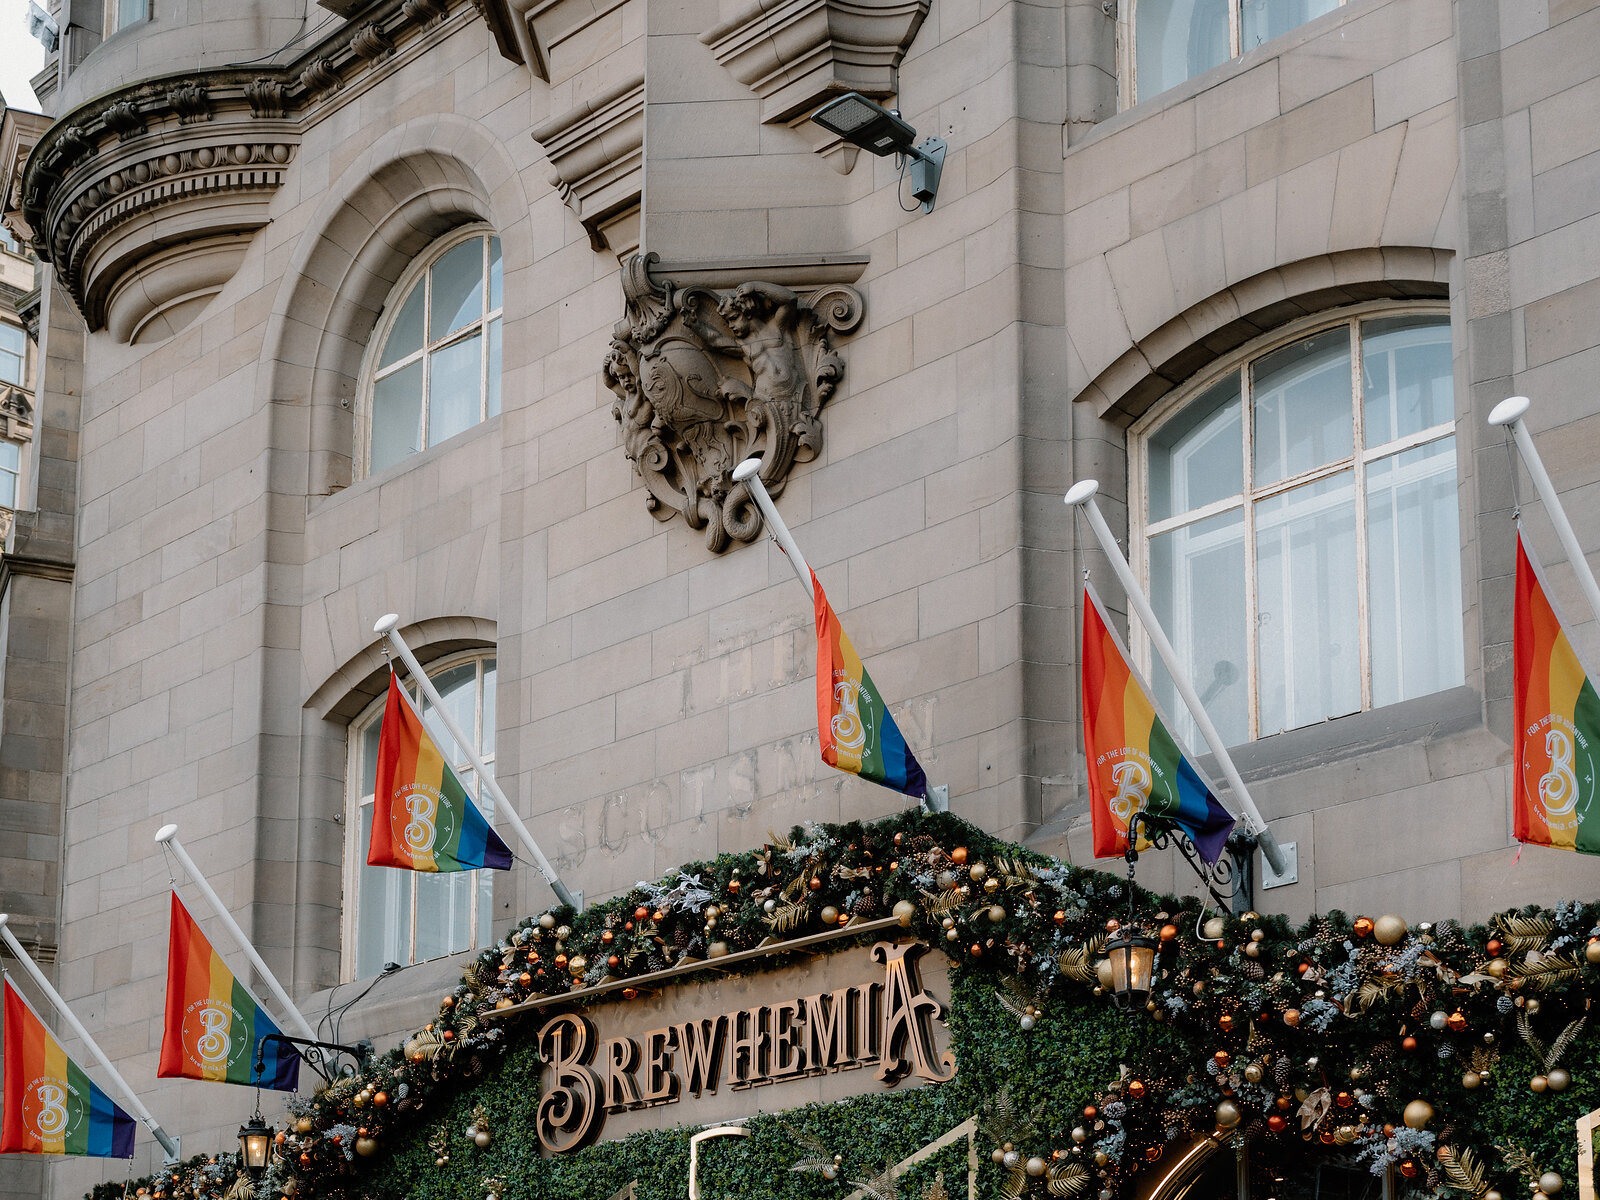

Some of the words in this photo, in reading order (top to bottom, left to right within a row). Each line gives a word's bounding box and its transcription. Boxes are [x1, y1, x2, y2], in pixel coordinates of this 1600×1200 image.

[1526, 722, 1540, 736] FOR
[1096, 756, 1106, 767] FOR
[1106, 749, 1119, 760] THE
[1139, 751, 1164, 778] ADVENTURE
[1538, 729, 1579, 816] B
[428, 786, 452, 808] ADVENTURE
[404, 794, 437, 852] B
[186, 1005, 195, 1014] FOR
[194, 1000, 202, 1008] THE
[222, 1001, 244, 1021] ADVENTURE
[197, 1008, 232, 1062] B
[536, 941, 959, 1153] BREWHEMIA
[37, 1084, 69, 1134] B
